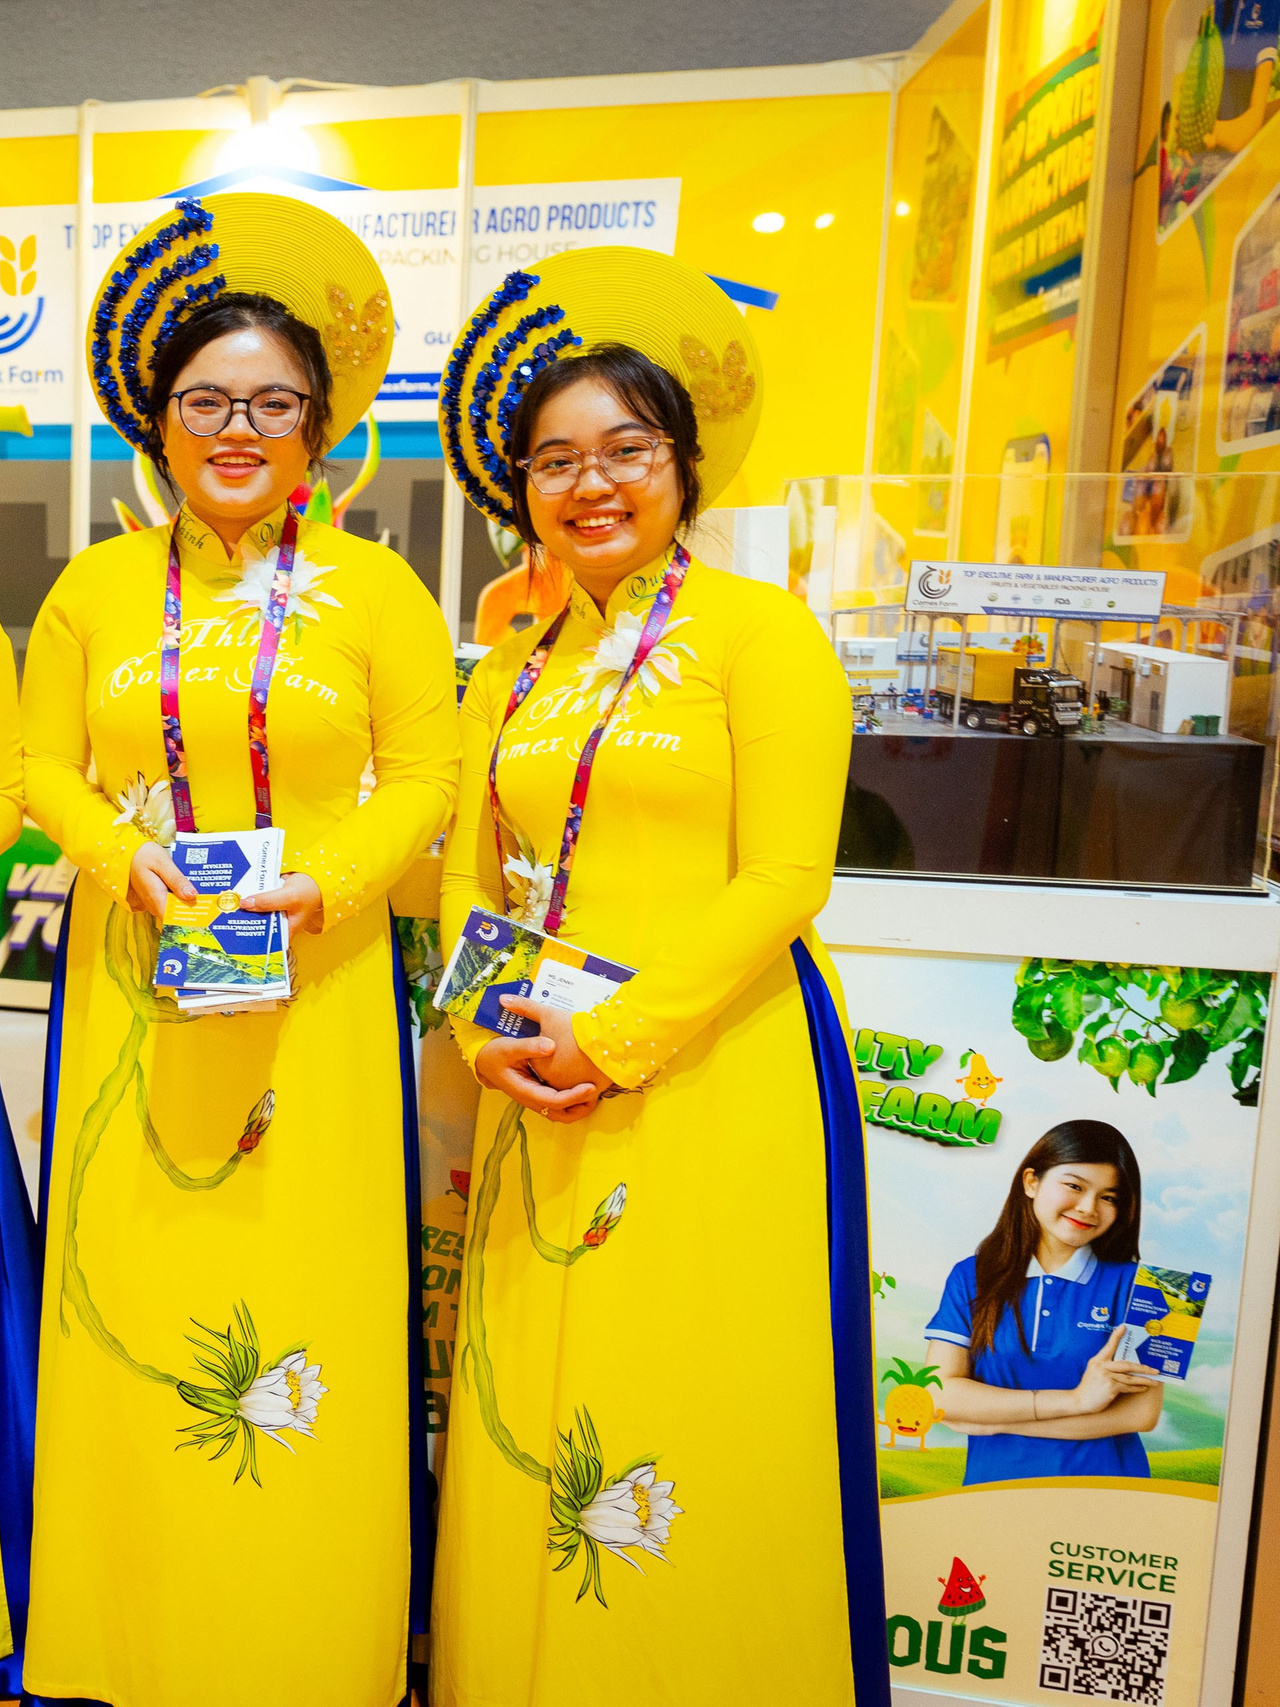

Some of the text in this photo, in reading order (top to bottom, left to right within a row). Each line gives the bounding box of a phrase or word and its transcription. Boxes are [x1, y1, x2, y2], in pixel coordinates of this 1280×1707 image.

[486, 206, 540, 233] AGRO
[547, 200, 657, 231] PRODUCTS
[9, 366, 63, 384] Farm
[1050, 1541, 1178, 1571] CUSTOMER
[1048, 1560, 1176, 1594] SERVICE
